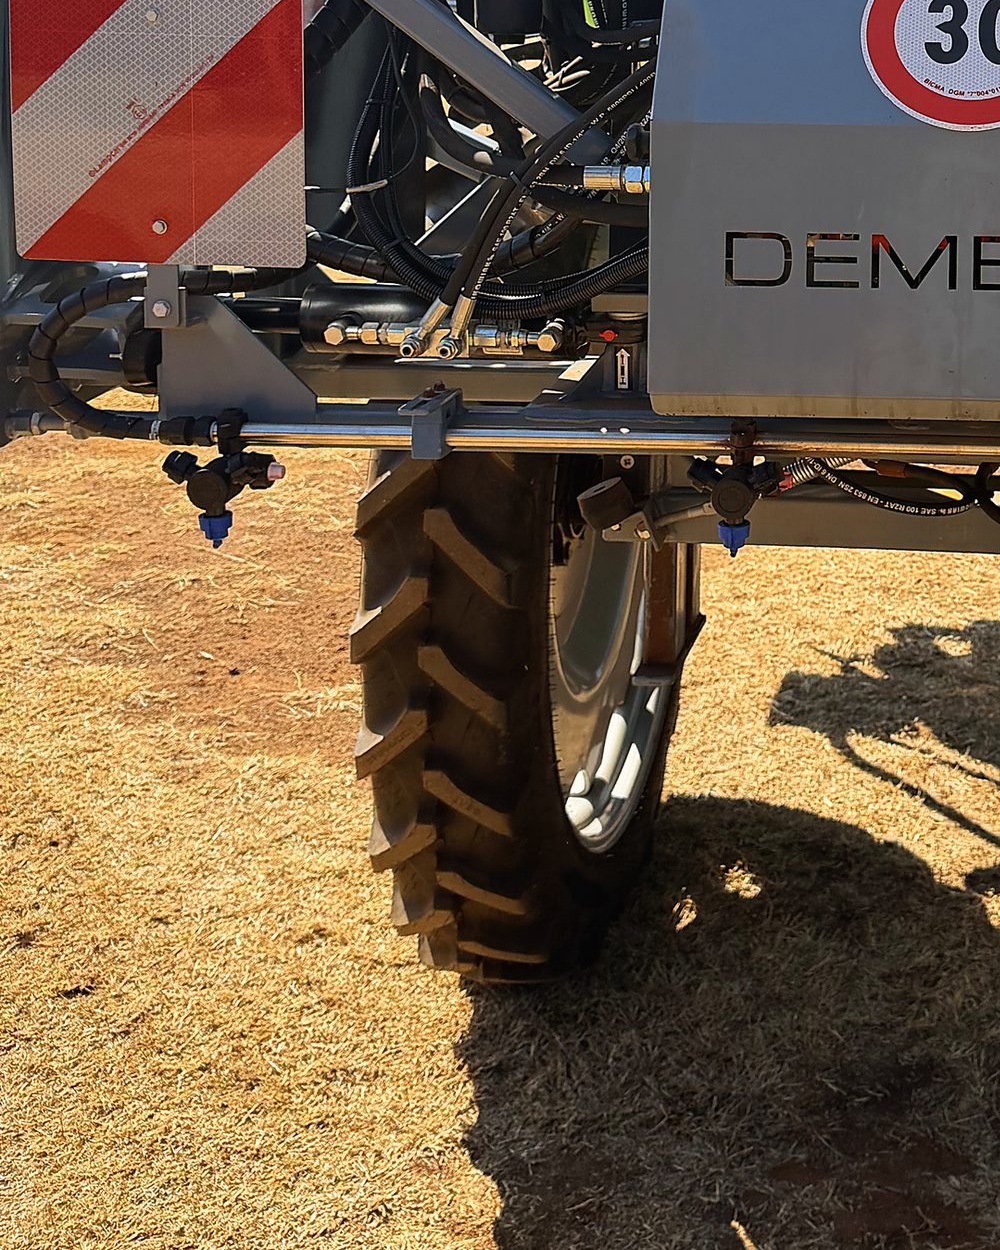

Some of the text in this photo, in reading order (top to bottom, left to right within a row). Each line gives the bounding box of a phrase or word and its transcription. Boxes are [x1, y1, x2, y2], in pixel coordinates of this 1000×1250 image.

[923, 78, 945, 93] BICMA
[825, 472, 838, 484] DN
[838, 480, 855, 494] 2SN
[853, 489, 868, 500] 853
[867, 494, 880, 505] EN
